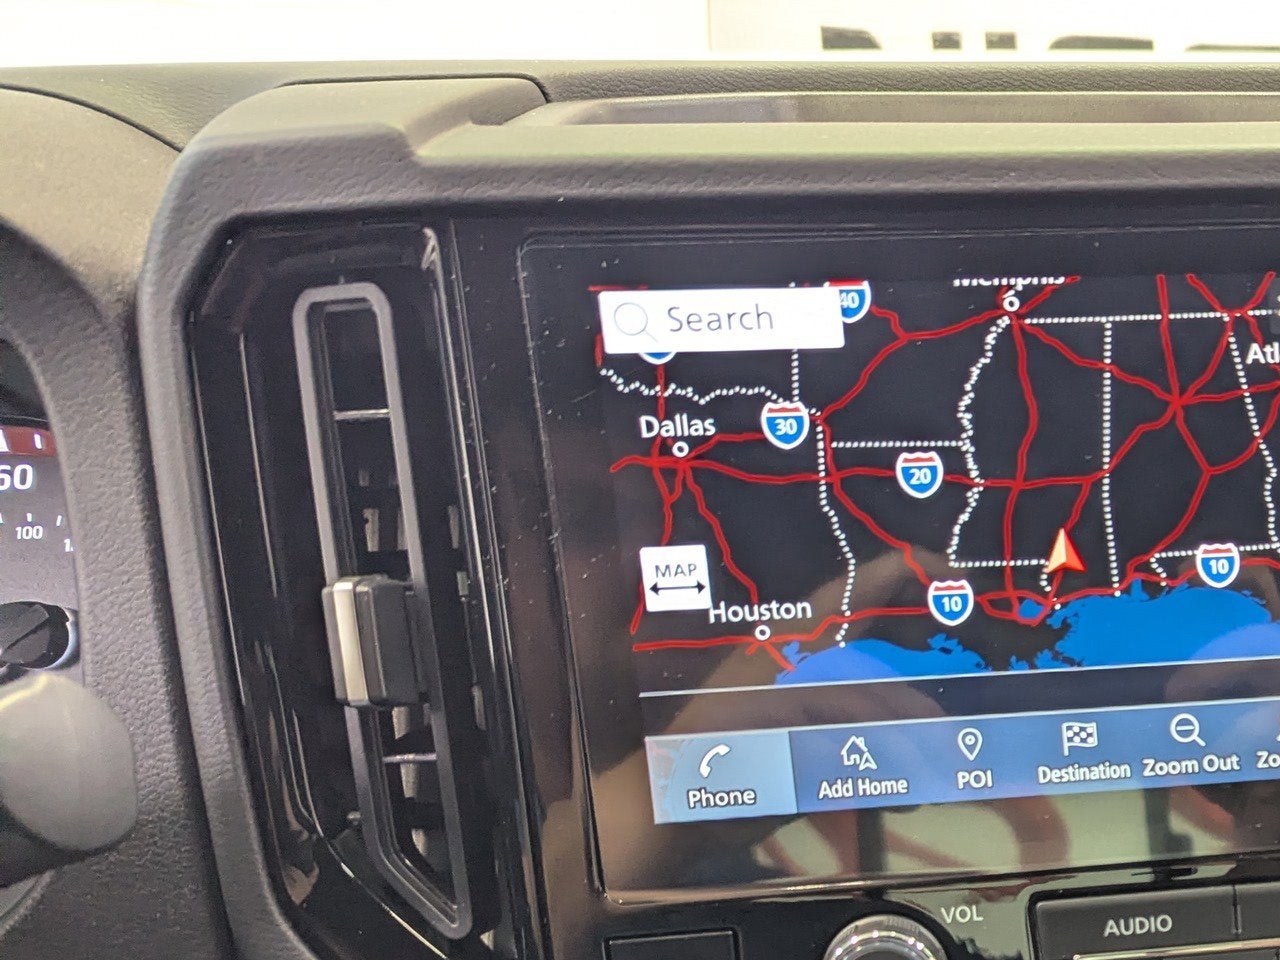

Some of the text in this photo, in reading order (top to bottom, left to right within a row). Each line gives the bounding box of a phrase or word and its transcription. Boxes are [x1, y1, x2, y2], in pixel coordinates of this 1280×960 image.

[841, 292, 860, 309] 40
[666, 304, 774, 333] Search
[640, 414, 716, 439] Dallas
[774, 420, 797, 436] 30
[909, 468, 932, 486] 20
[16, 526, 43, 540] 100
[654, 563, 698, 578] MAP
[1210, 558, 1229, 574] 10
[709, 600, 812, 624] Houston
[942, 596, 962, 612] 10
[1038, 761, 1131, 784] Destination
[1143, 754, 1240, 777] Zoom Out
[818, 776, 908, 800] Add Home
[957, 770, 994, 790] POI
[688, 788, 756, 808] Phone
[941, 906, 984, 924] VOL
[1103, 914, 1172, 937] AUDIO
